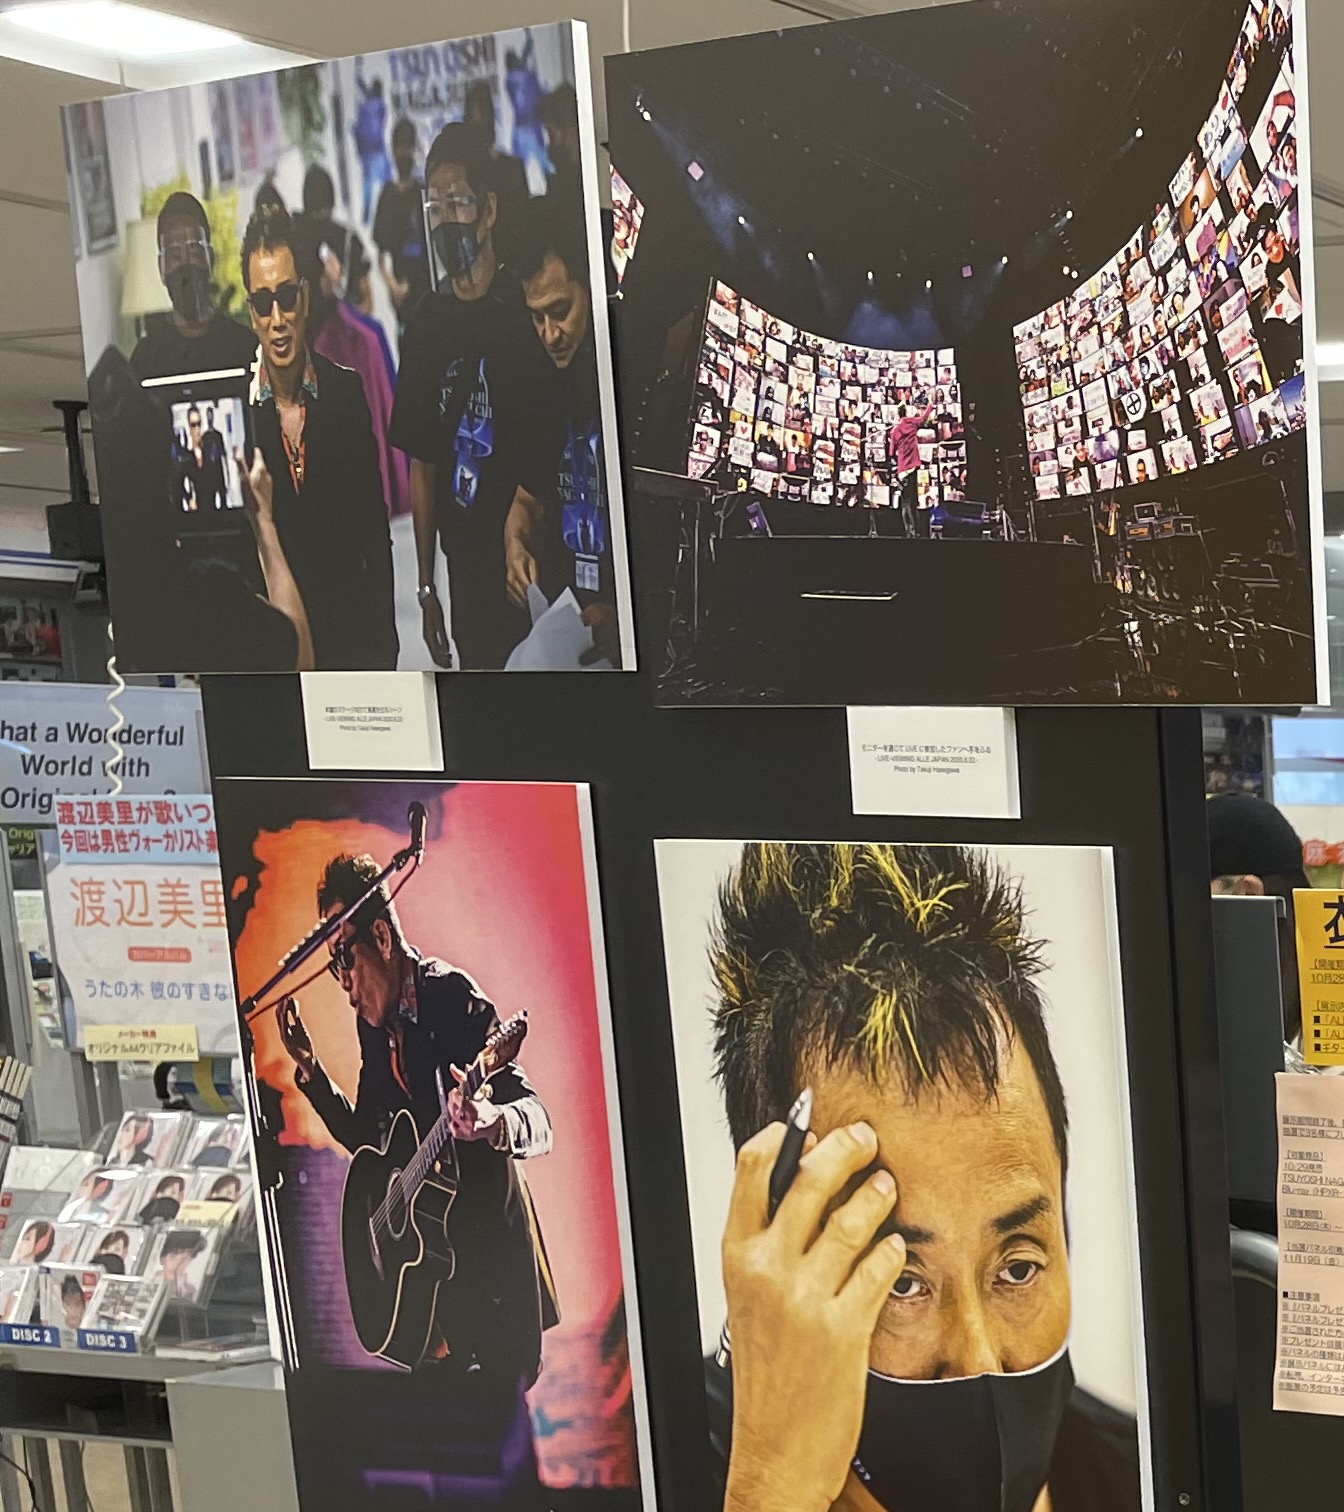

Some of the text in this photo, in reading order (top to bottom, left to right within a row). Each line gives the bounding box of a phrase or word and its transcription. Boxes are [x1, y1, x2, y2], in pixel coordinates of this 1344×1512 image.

[45, 724, 59, 743] a
[66, 722, 184, 747] Wonderful
[20, 754, 93, 777] World
[86, 979, 144, 999] うたの木
[12, 1328, 51, 1342] DISC 2
[86, 1334, 127, 1349] DISC 3
